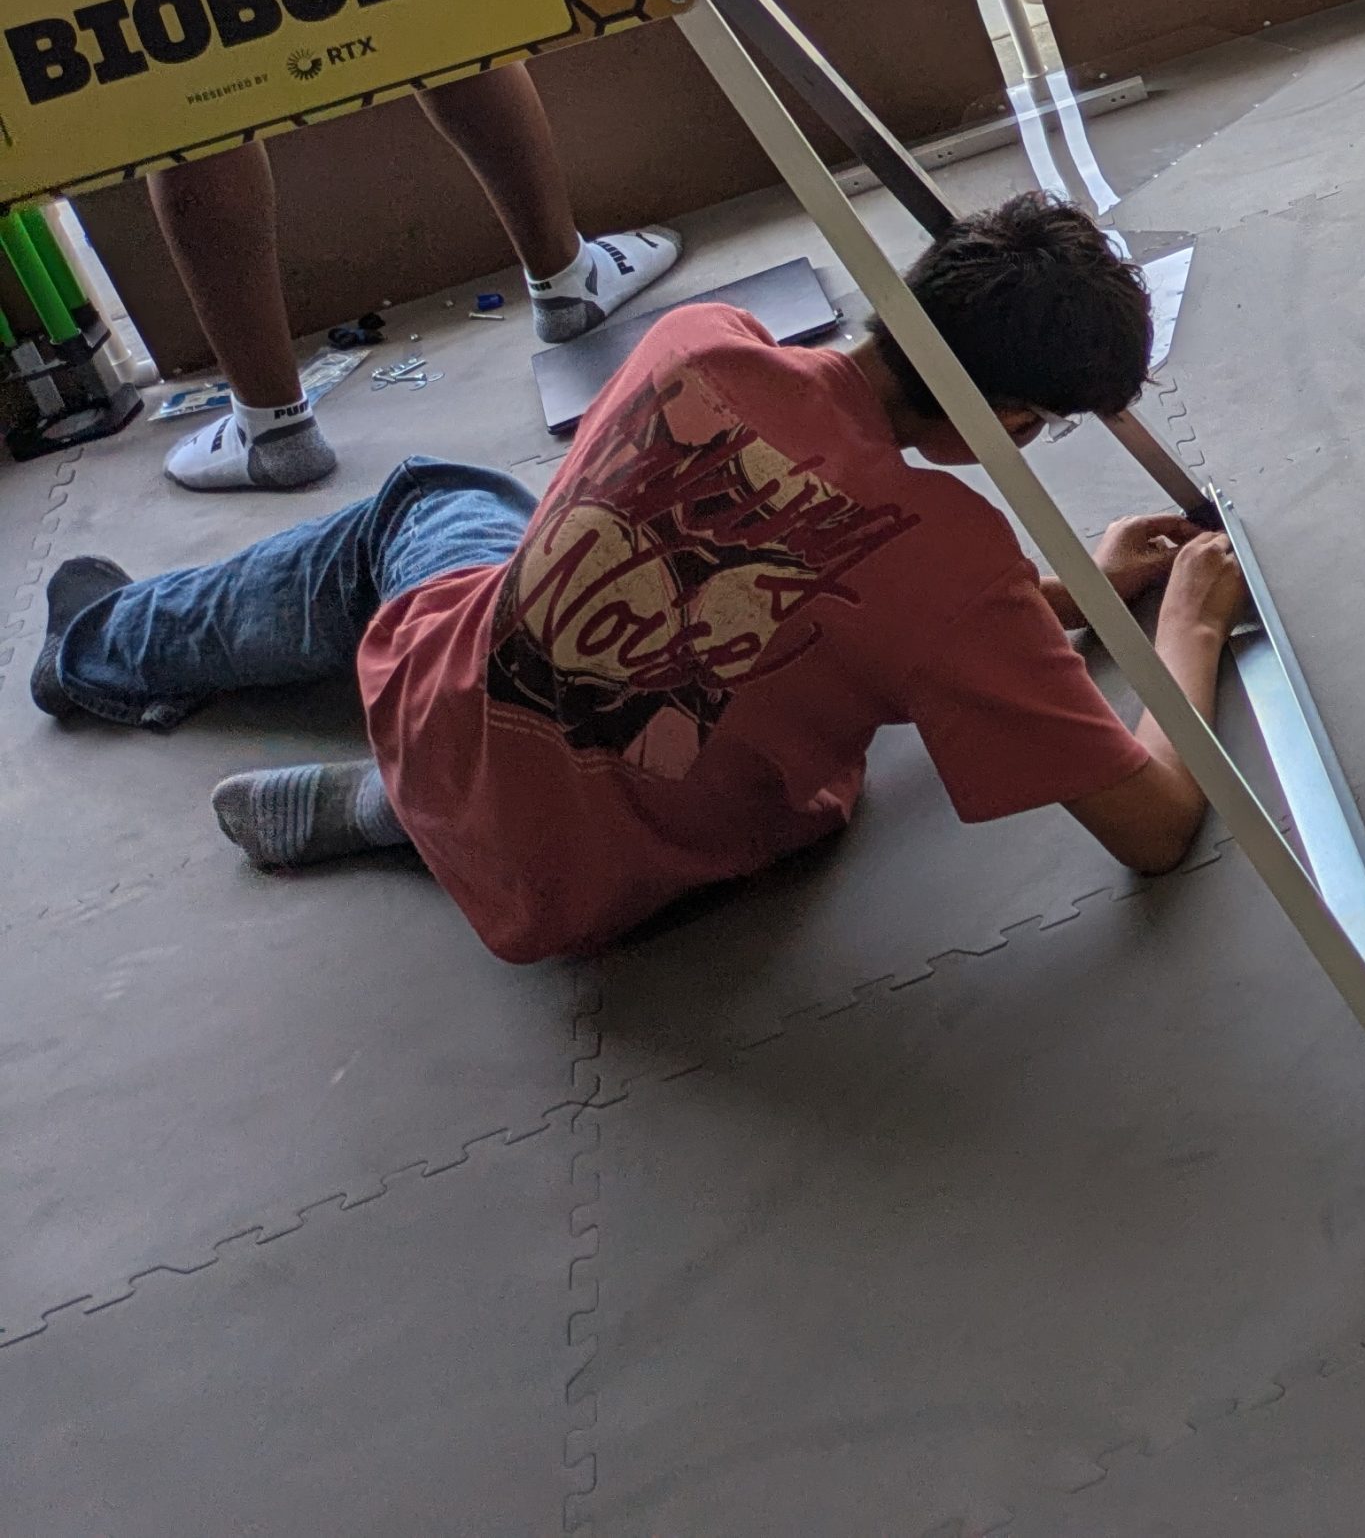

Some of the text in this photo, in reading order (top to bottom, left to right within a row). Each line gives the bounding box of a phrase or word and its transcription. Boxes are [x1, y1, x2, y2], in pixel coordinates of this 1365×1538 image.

[186, 35, 377, 105] PRESENTED BY RTX
[496, 527, 824, 690] Noise
